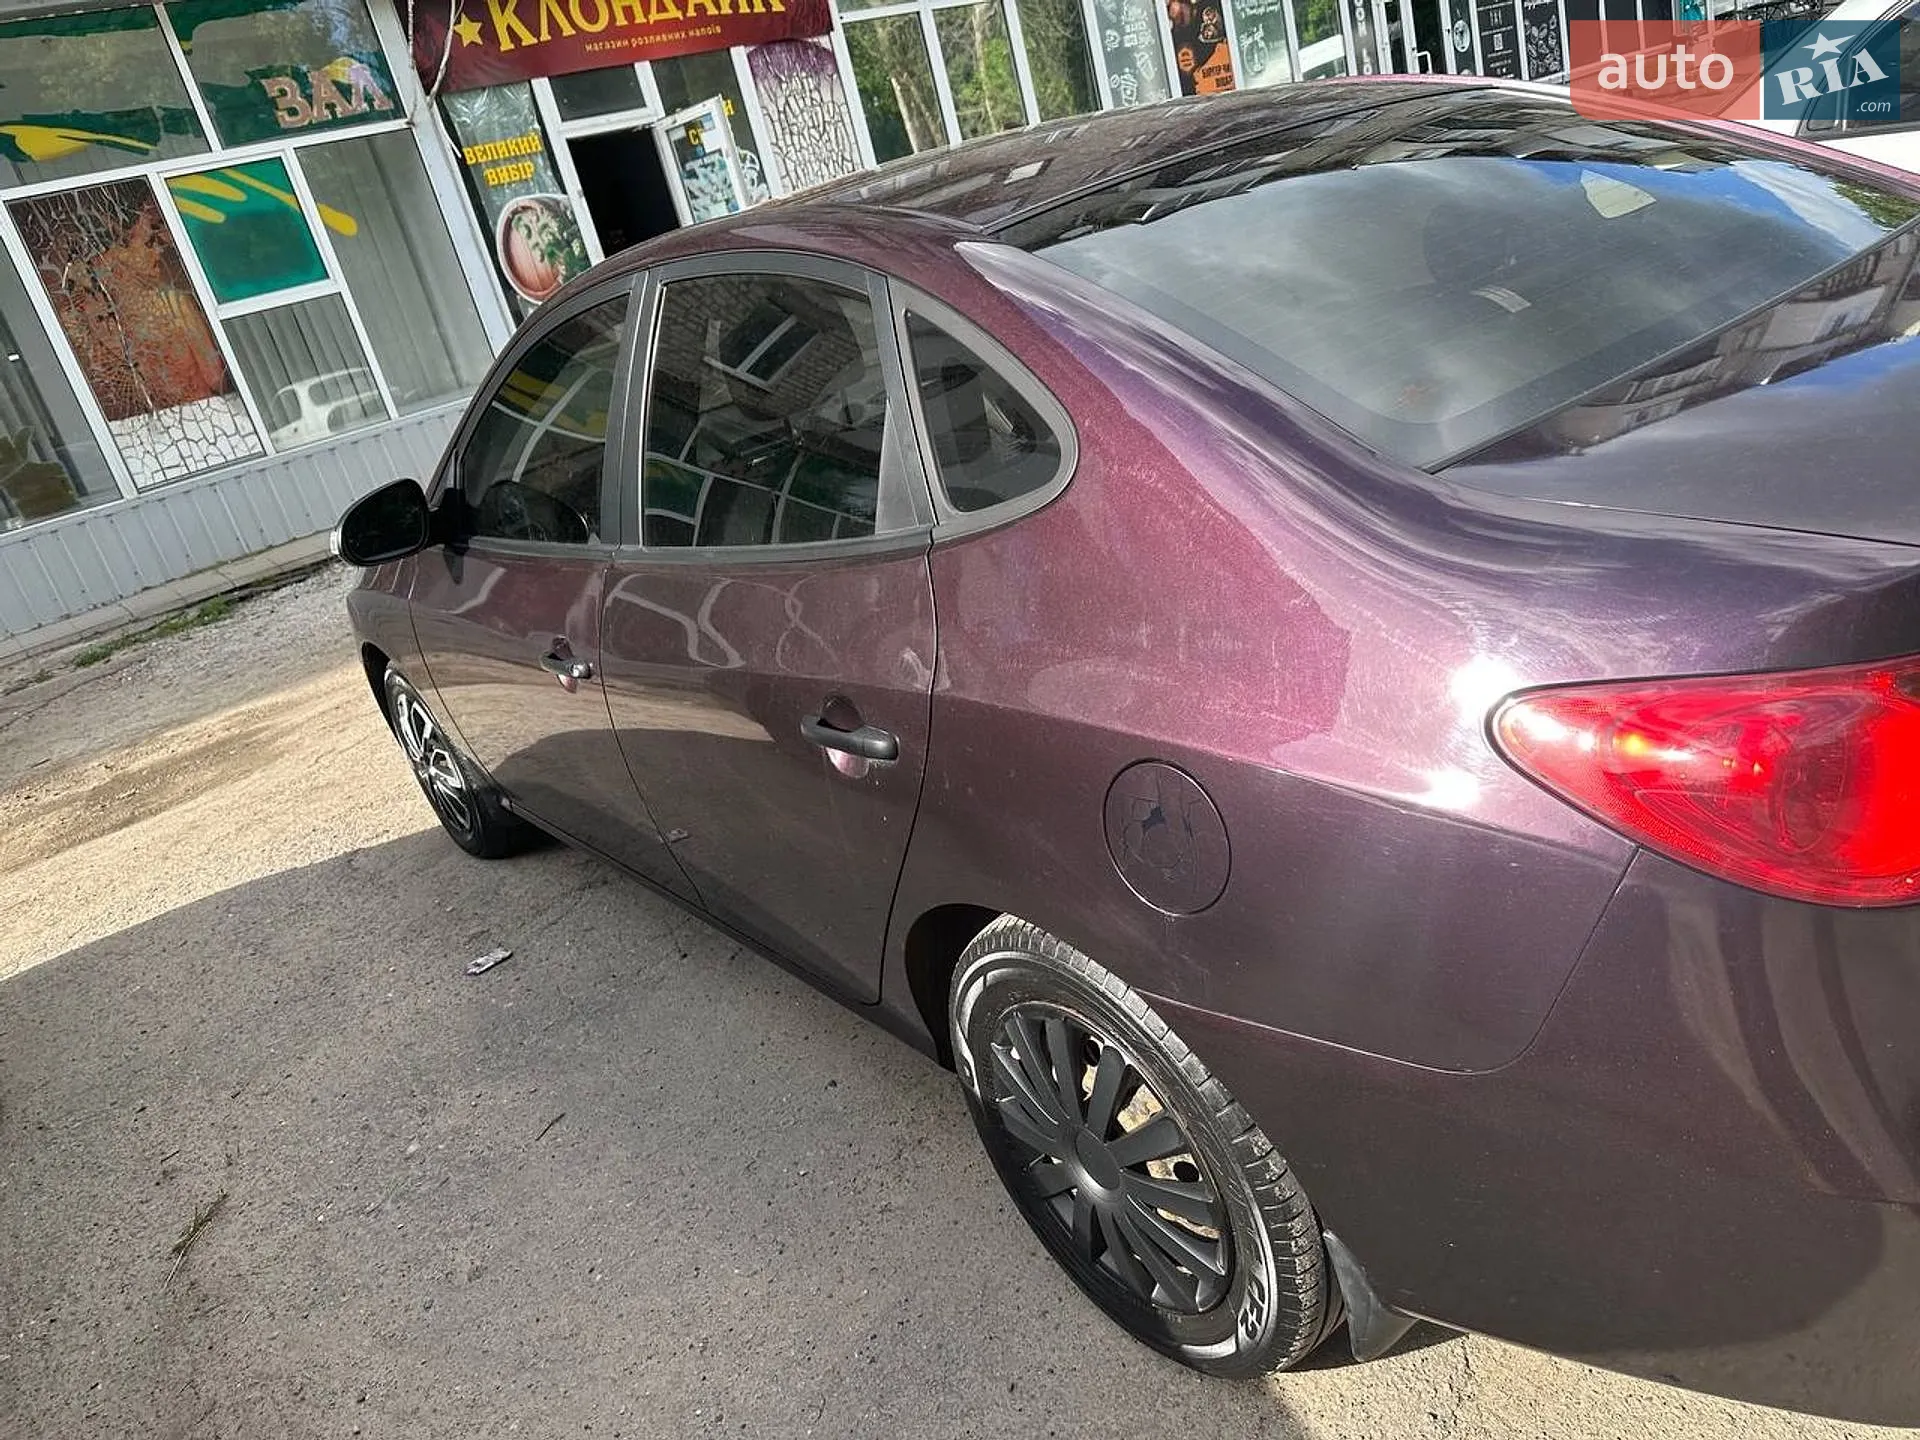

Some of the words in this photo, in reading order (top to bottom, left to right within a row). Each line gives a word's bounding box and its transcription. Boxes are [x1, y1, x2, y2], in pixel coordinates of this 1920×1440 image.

[486, 0, 785, 51] КЛОНД
[260, 63, 394, 129] ЗАЛ
[462, 132, 542, 166] ВЕЛИКИЙ
[484, 161, 534, 186] ВИБІР
